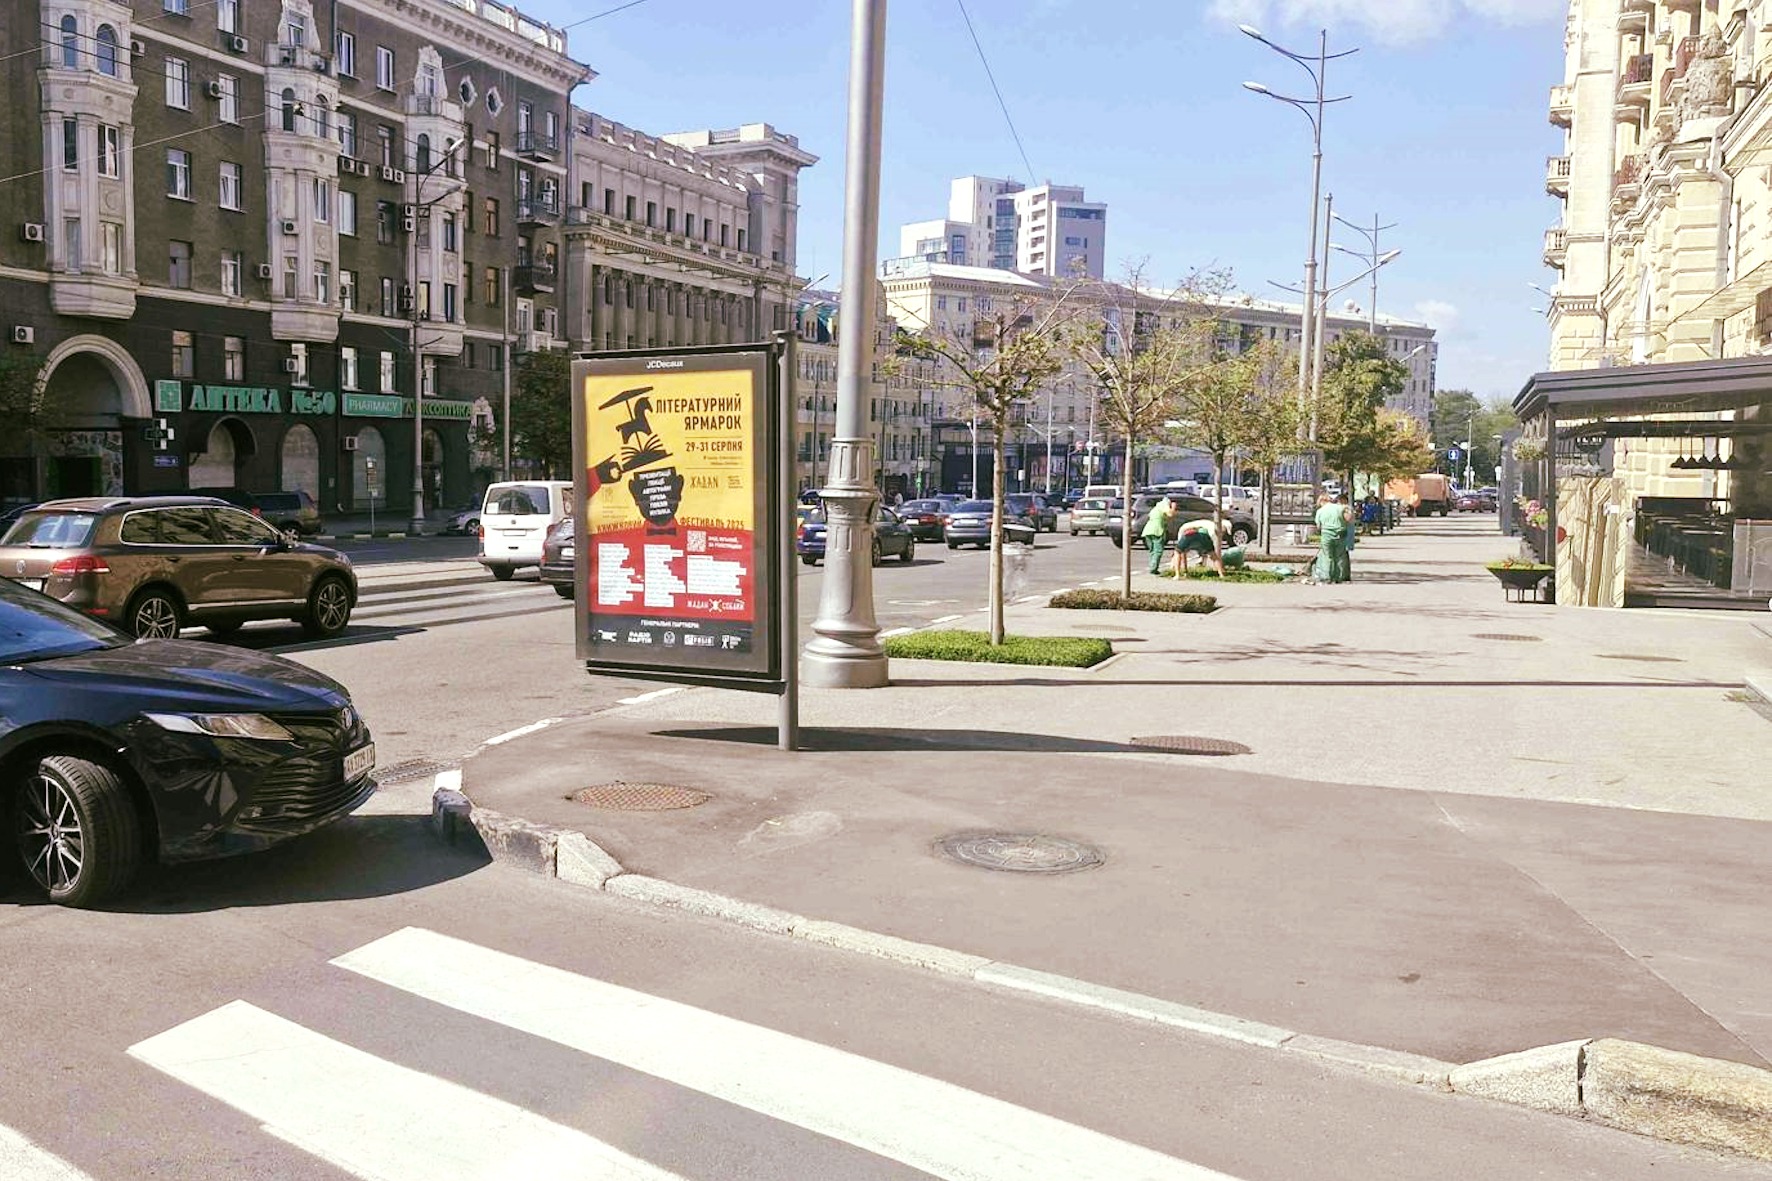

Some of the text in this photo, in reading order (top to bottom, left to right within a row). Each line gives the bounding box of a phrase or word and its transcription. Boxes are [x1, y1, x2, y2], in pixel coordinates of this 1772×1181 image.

[646, 360, 684, 369] JCDecaux
[189, 385, 336, 415] АПТЕКА №50
[350, 399, 399, 412] PHARMACY
[656, 393, 741, 414] ЛІТЕРАТУРНИЙ
[685, 415, 741, 431] ЯРМАРОК
[685, 441, 743, 453] 29-31 СЕРПНЯ
[680, 517, 745, 530] ФЕСТИВАЛЬ 2025
